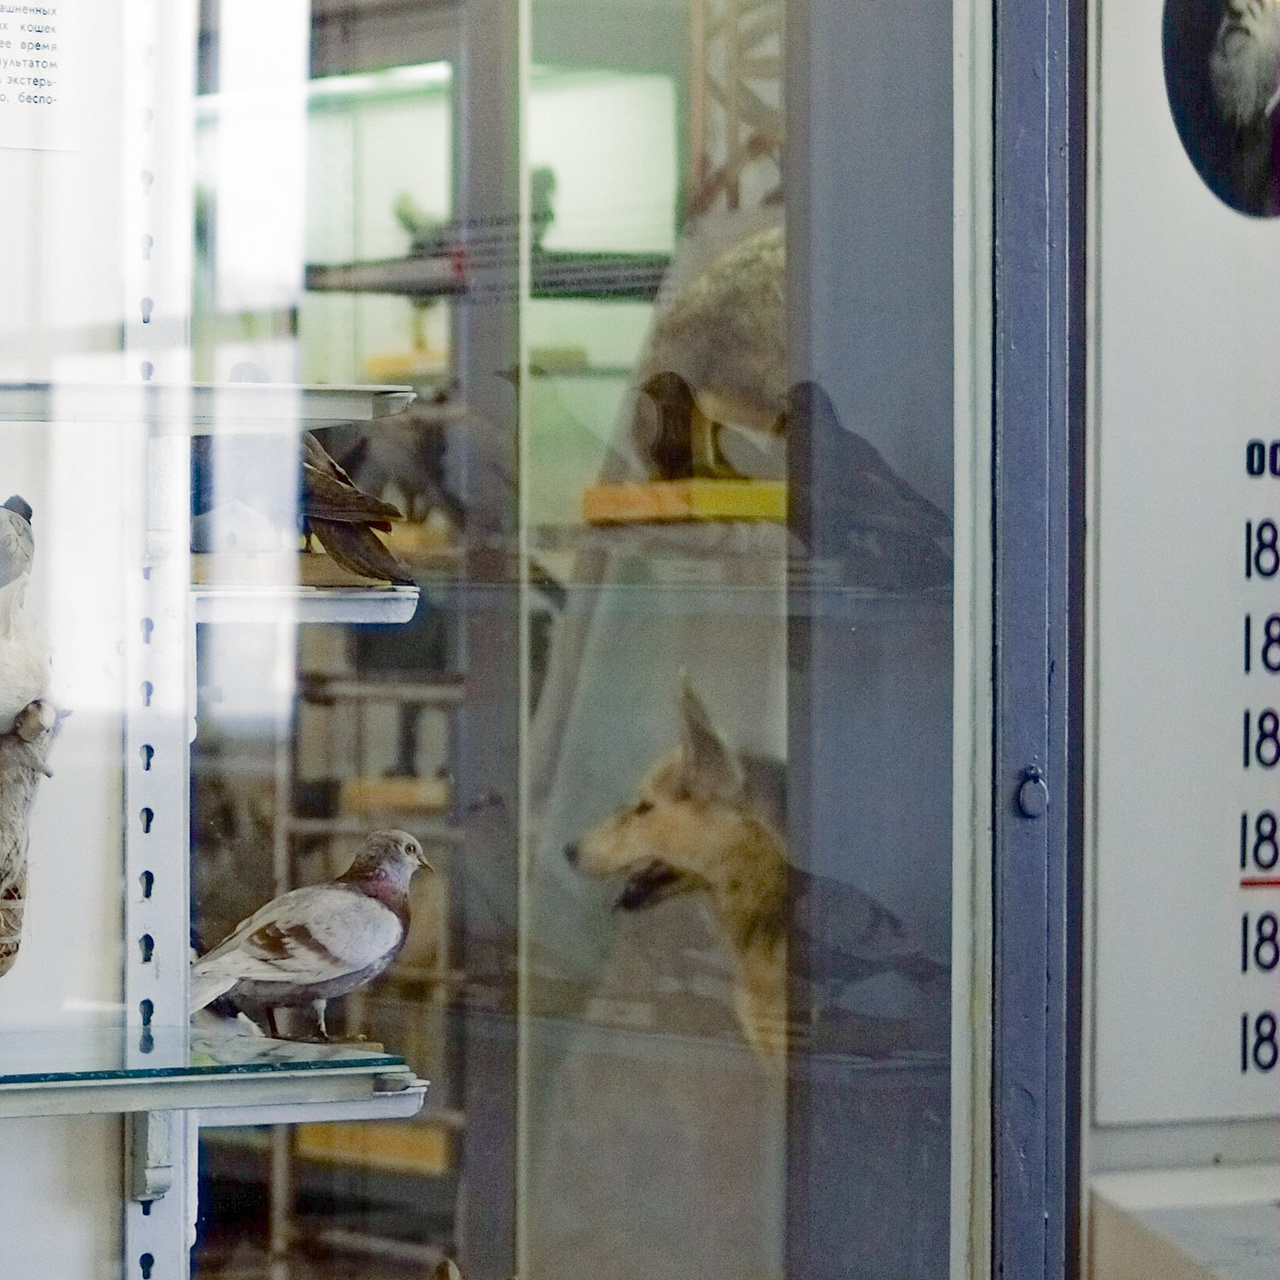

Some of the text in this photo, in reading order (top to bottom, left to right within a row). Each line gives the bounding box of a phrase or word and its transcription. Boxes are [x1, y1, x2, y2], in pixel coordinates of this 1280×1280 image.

[20, 23, 57, 34] кошек
[20, 41, 58, 53] время
[7, 76, 58, 87] экстерь-
[18, 91, 58, 105] беспо-
